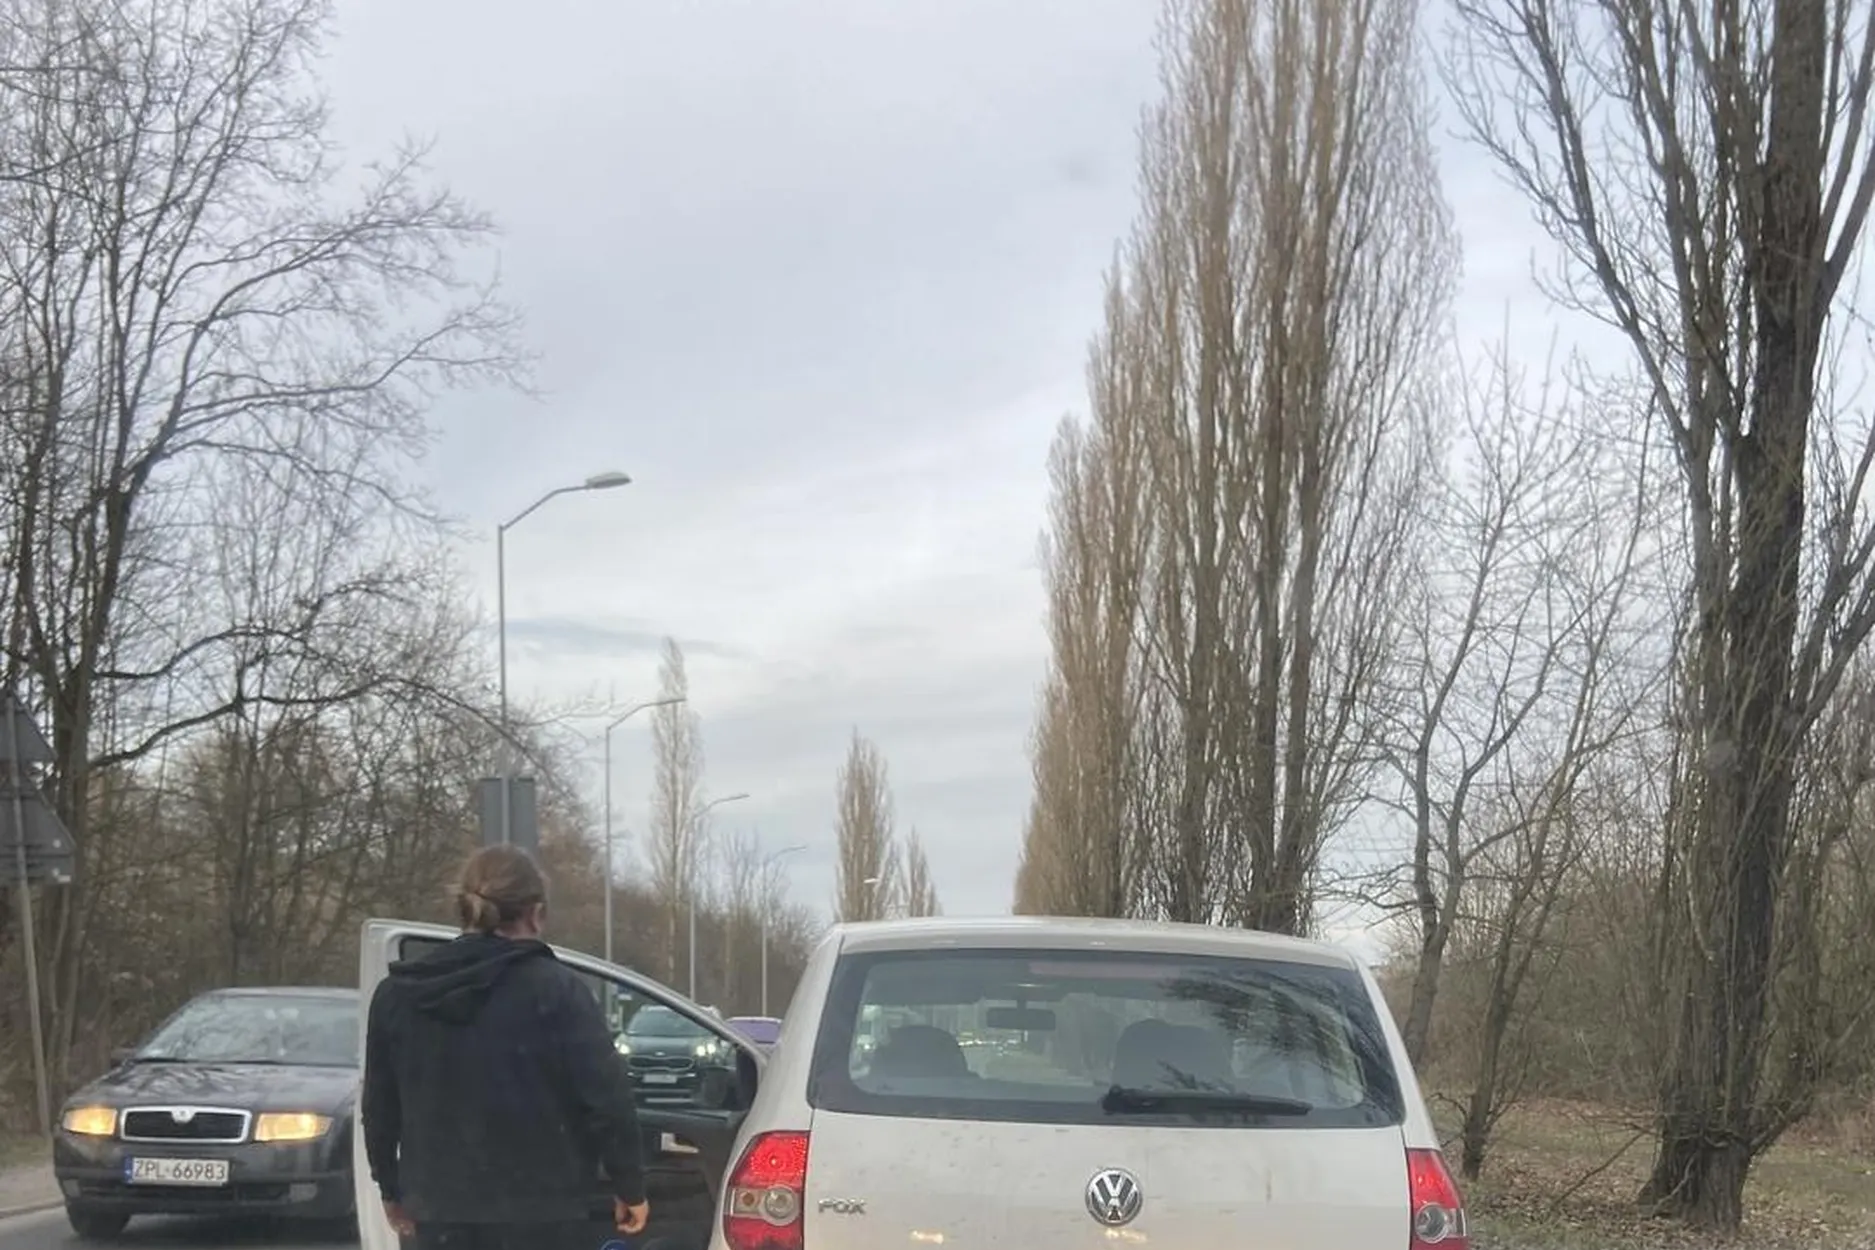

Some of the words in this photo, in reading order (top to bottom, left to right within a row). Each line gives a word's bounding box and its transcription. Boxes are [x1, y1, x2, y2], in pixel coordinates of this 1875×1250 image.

[134, 1159, 166, 1178] ZPL
[172, 1162, 226, 1180] 66983
[818, 1199, 867, 1215] FOX
